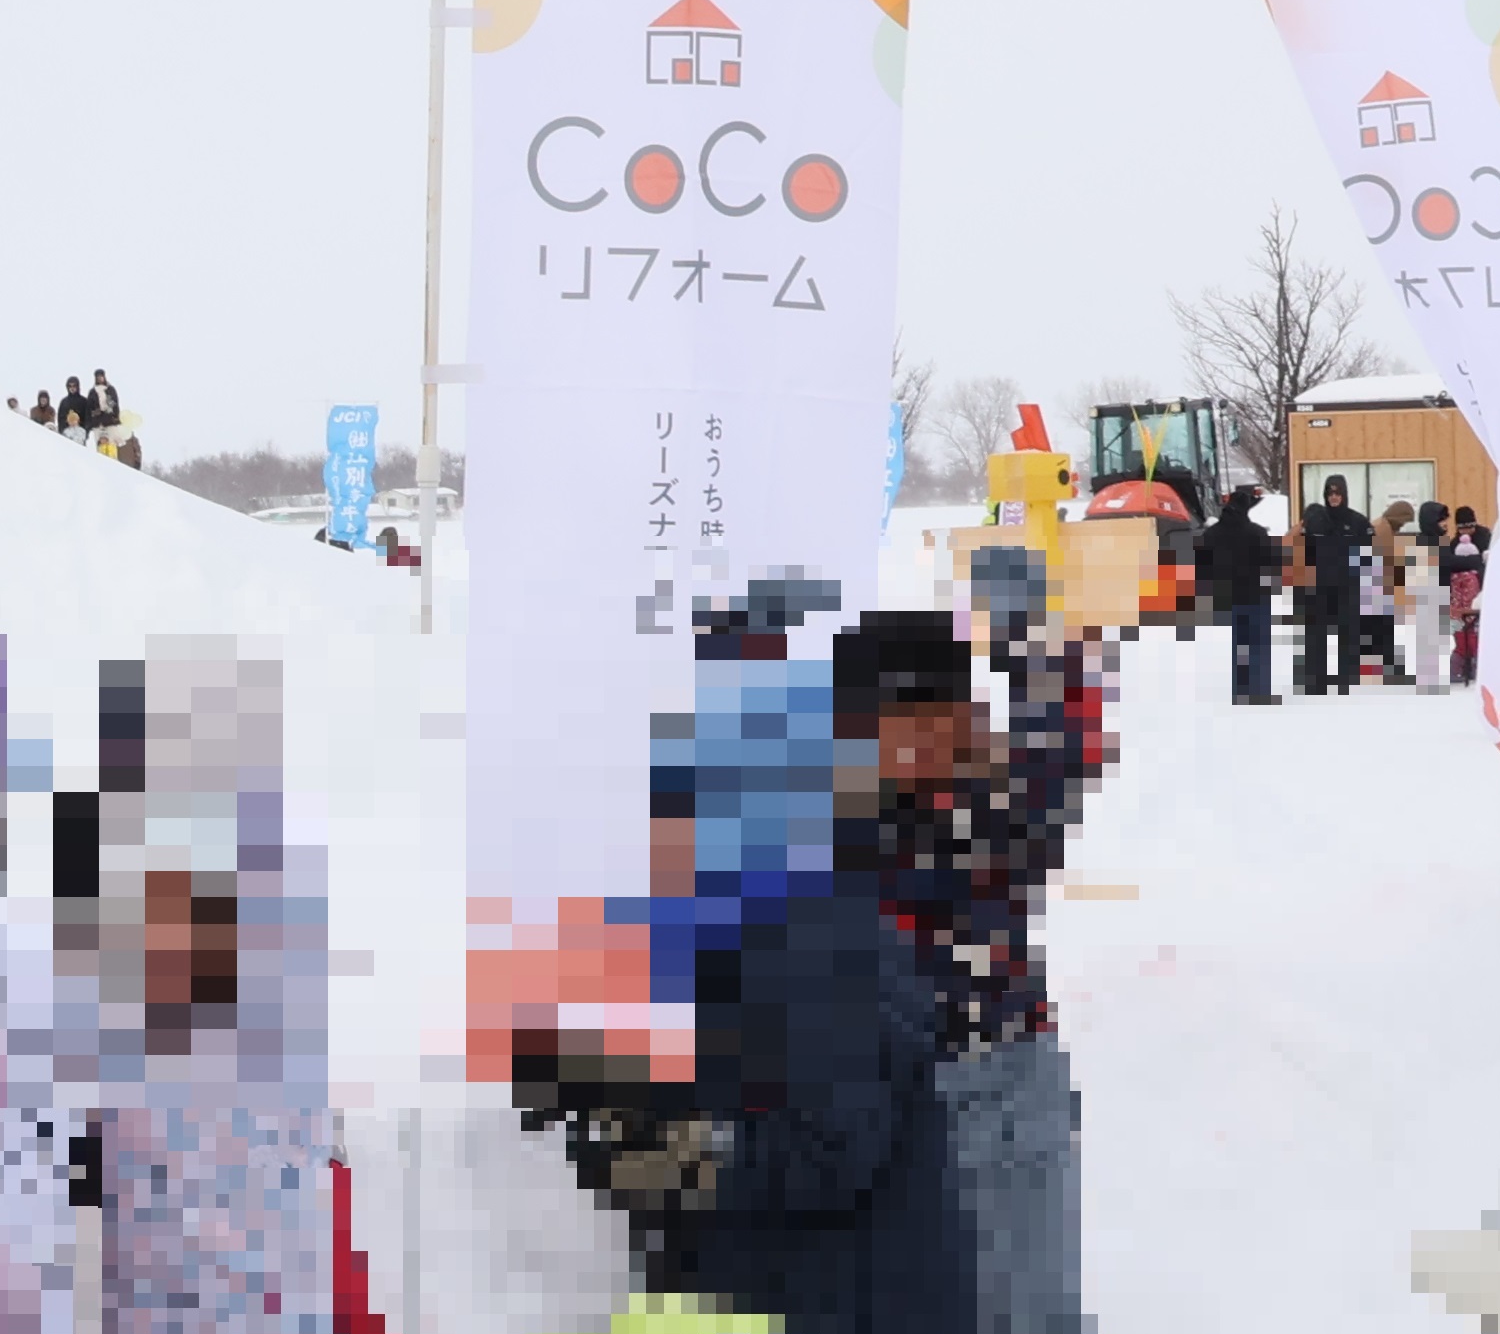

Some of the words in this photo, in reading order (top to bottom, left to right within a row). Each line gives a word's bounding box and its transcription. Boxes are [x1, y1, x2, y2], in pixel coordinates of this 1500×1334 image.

[527, 116, 849, 223] CoCo
[539, 245, 826, 311] リフォーム
[333, 411, 361, 423] JCI
